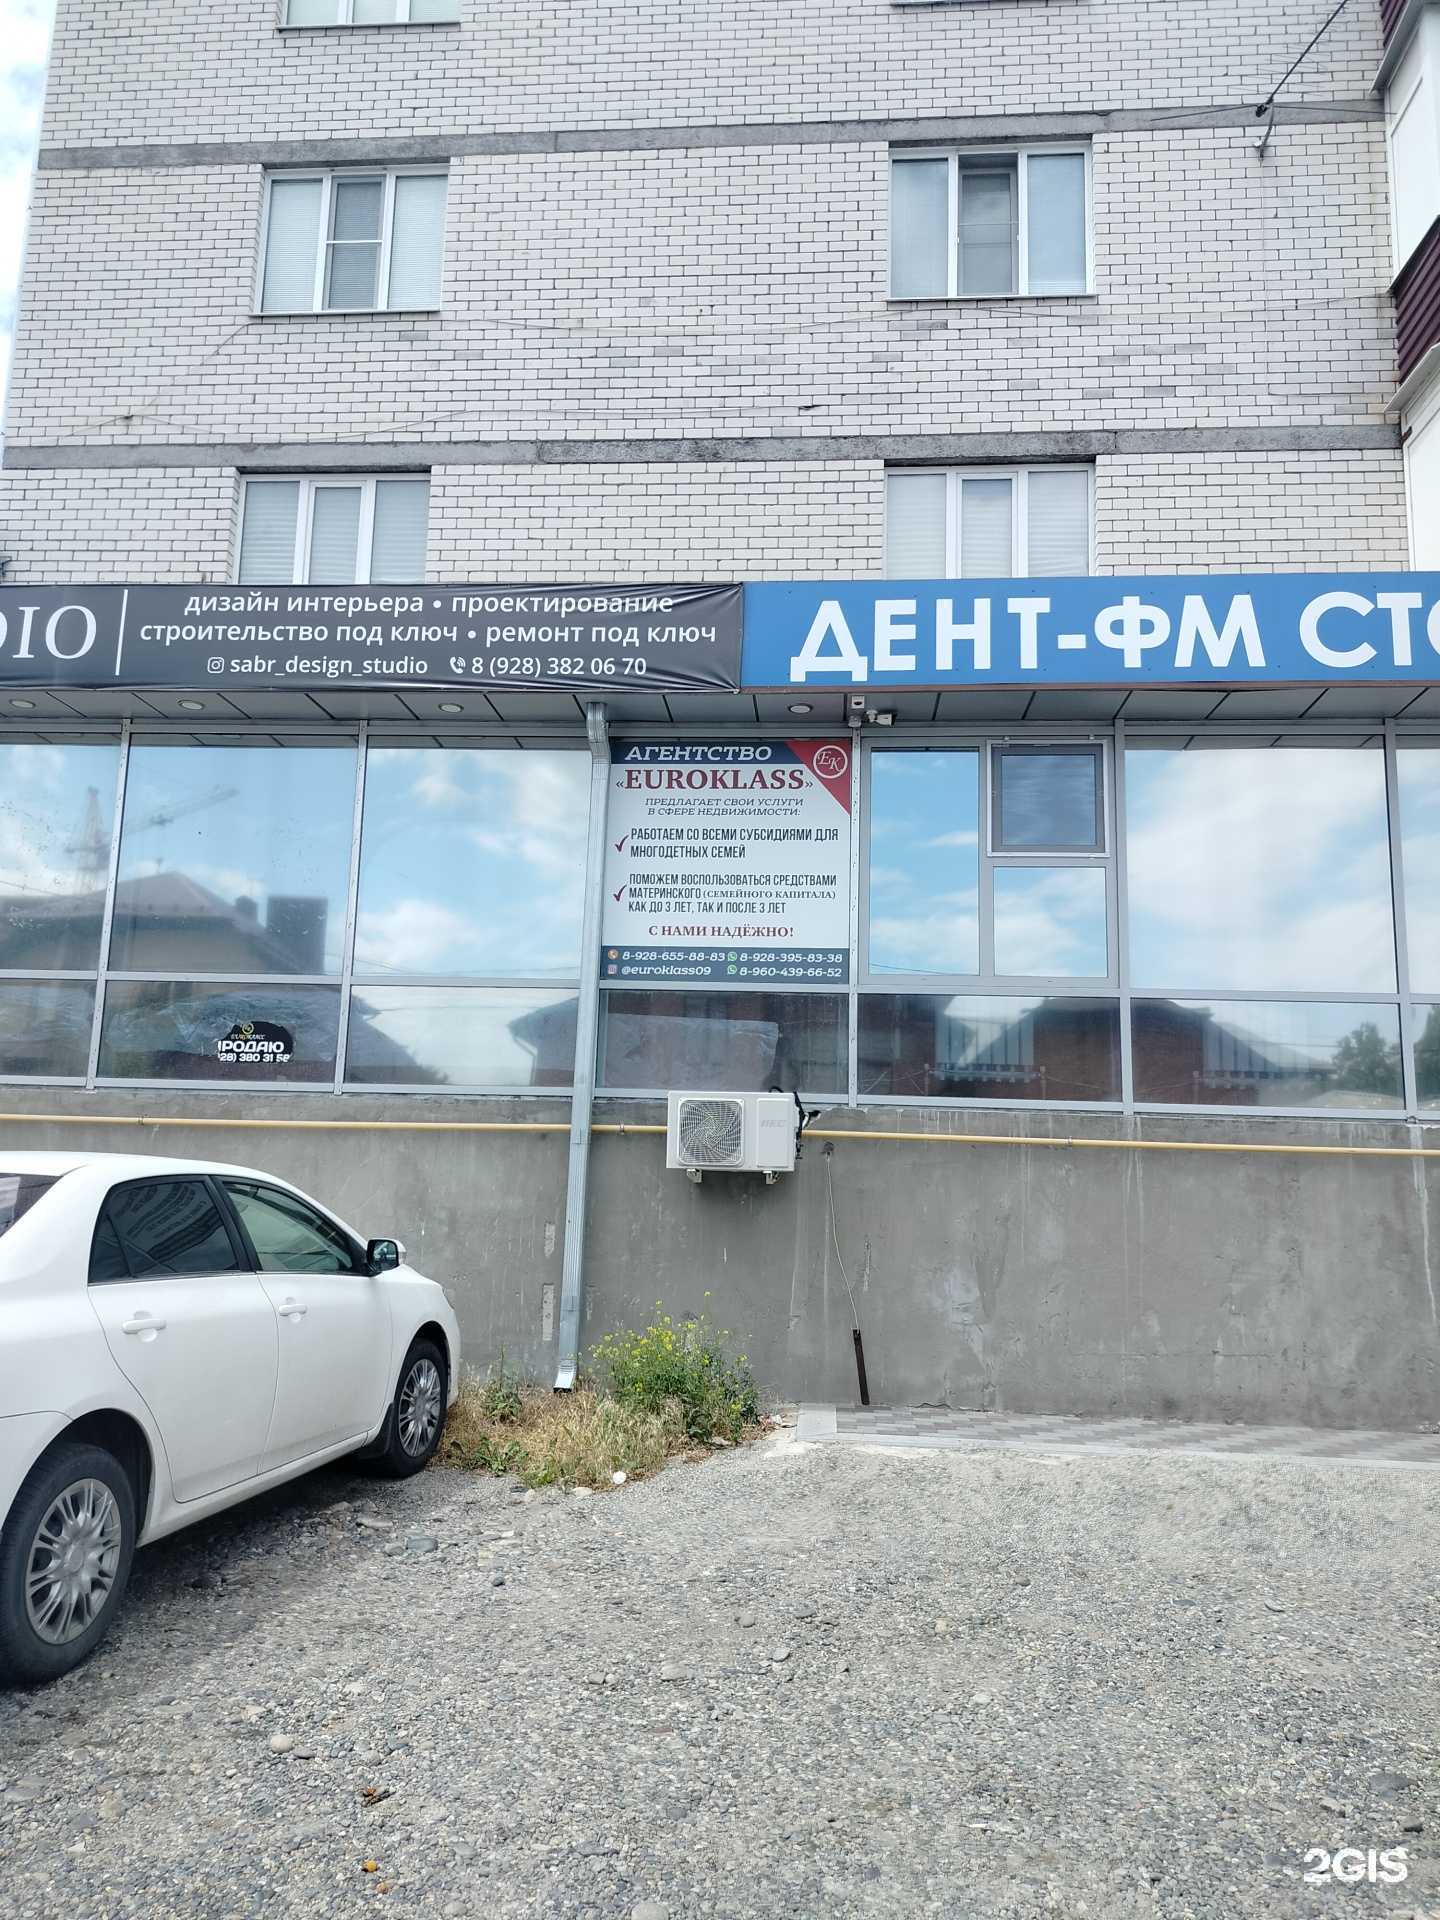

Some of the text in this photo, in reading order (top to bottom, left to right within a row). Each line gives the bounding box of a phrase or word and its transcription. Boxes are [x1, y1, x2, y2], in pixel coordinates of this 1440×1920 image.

[184, 591, 673, 618] дизайн интерьера проектирование
[0, 605, 97, 659] IO
[140, 623, 716, 646] строительство под ключ ремонт под ключ
[790, 591, 1440, 682] ДЕНТ-ФМ СТ
[230, 657, 428, 678] sabr_design_studio
[471, 657, 647, 677] 8 (928) 382 06 70
[624, 746, 772, 761] АГЕНТСТВО
[645, 798, 804, 807] ПРЕДЛАГАЕТ СВОИ УСЛУГИ
[648, 807, 801, 816] В СФЕРЕ НЕДВИЖИМОСТИ:
[630, 828, 839, 842] РАБОТАЕМ СО ВСЕМИ СУБСИДИЯМИ ДЛЯ
[630, 844, 746, 859] МНОГОДЕТНЫХ СЕМЕЙ
[629, 873, 837, 887] ПОМОЖЕМ ВОСПОЛЬЗОВАТЬСЯ СРЕДСТВАМИ
[629, 887, 836, 900] МАТЕРИНСКОГО (СЕМЕЙНОГО КАПИТАЛА)
[629, 902, 786, 914] КАК ДО 3 ЛЕТ, ТАК И ПОСЛЕ 3 ЛЕТ
[648, 922, 794, 939] С НАМИ НАДЁЖНО!
[622, 952, 726, 962] 8-928-655-88-83
[740, 953, 843, 963] 8-928-395-83-38
[621, 965, 712, 976] @euroklass09
[740, 967, 843, 977] 8-960-439-66-52
[239, 1053, 261, 1062] 380
[263, 1053, 274, 1063] 31
